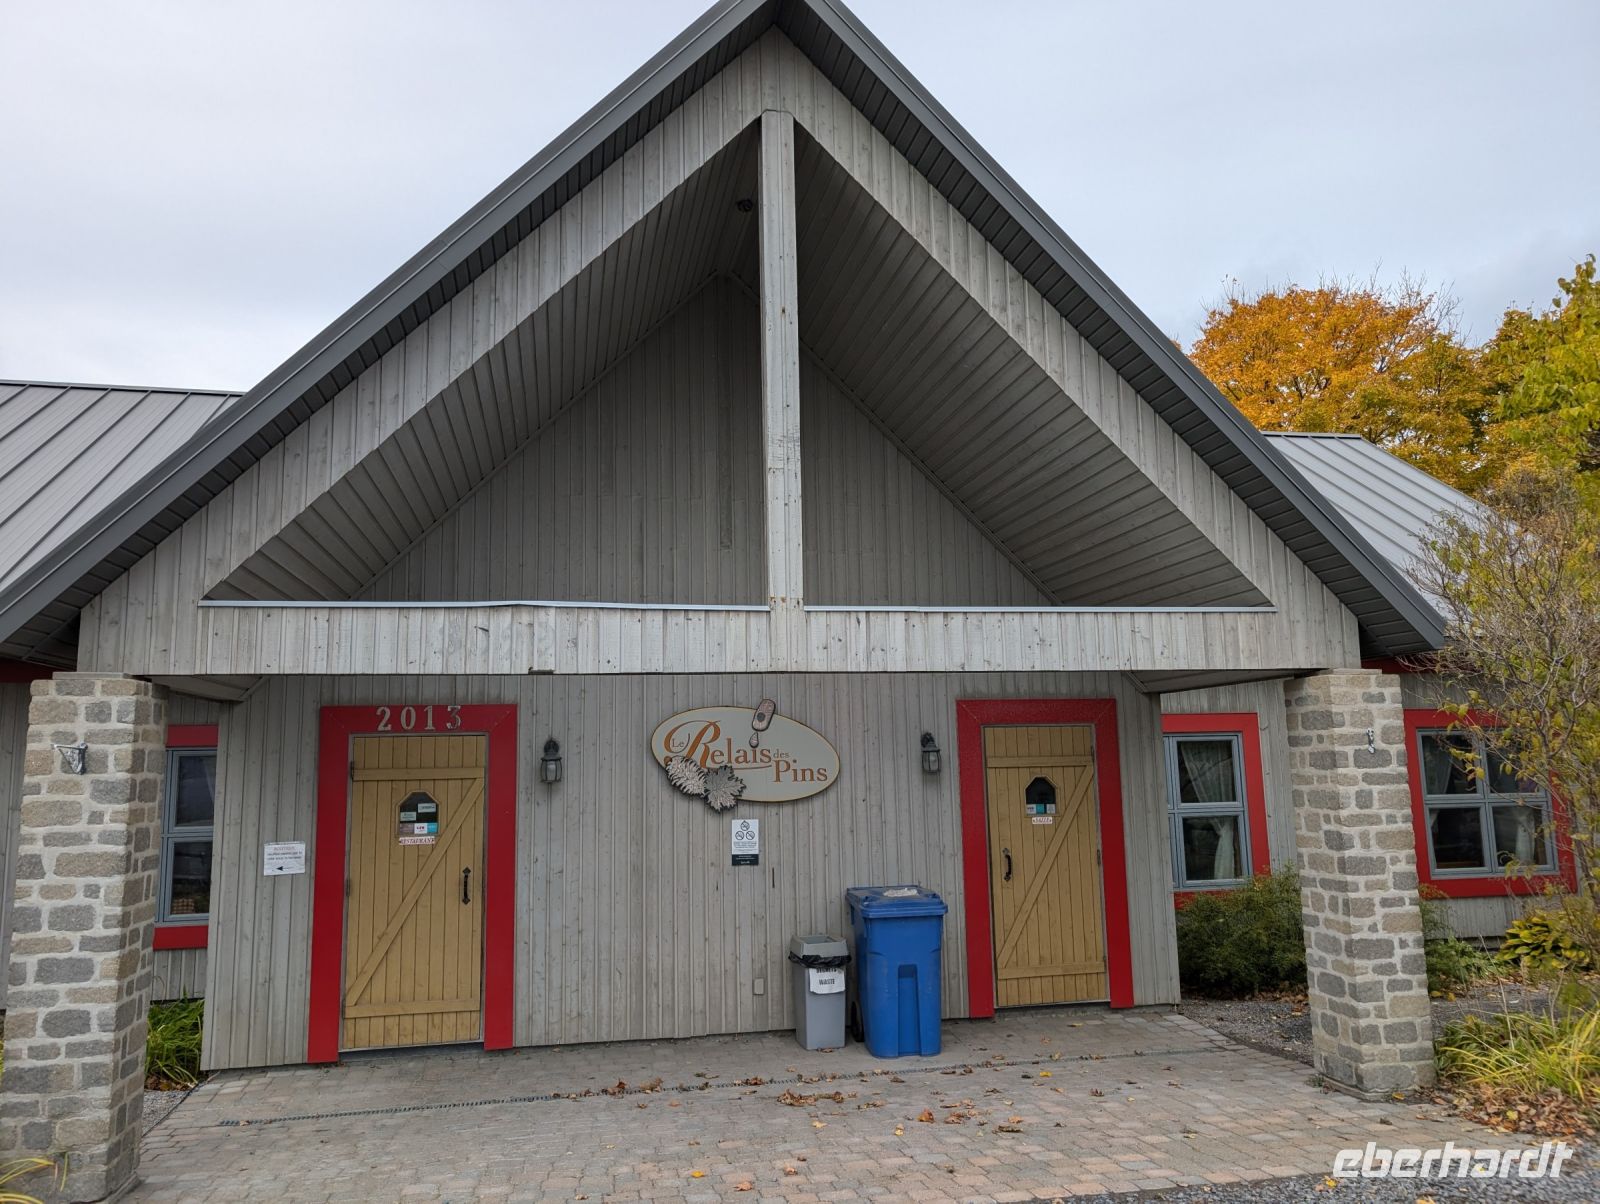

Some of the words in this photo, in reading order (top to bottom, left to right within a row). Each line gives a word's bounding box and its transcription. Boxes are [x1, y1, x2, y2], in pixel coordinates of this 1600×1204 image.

[376, 705, 462, 731] 2013
[663, 720, 773, 770] Relais
[671, 737, 686, 749] Le
[773, 748, 790, 759] des
[773, 758, 828, 783] Pins
[818, 978, 835, 986] WASTE
